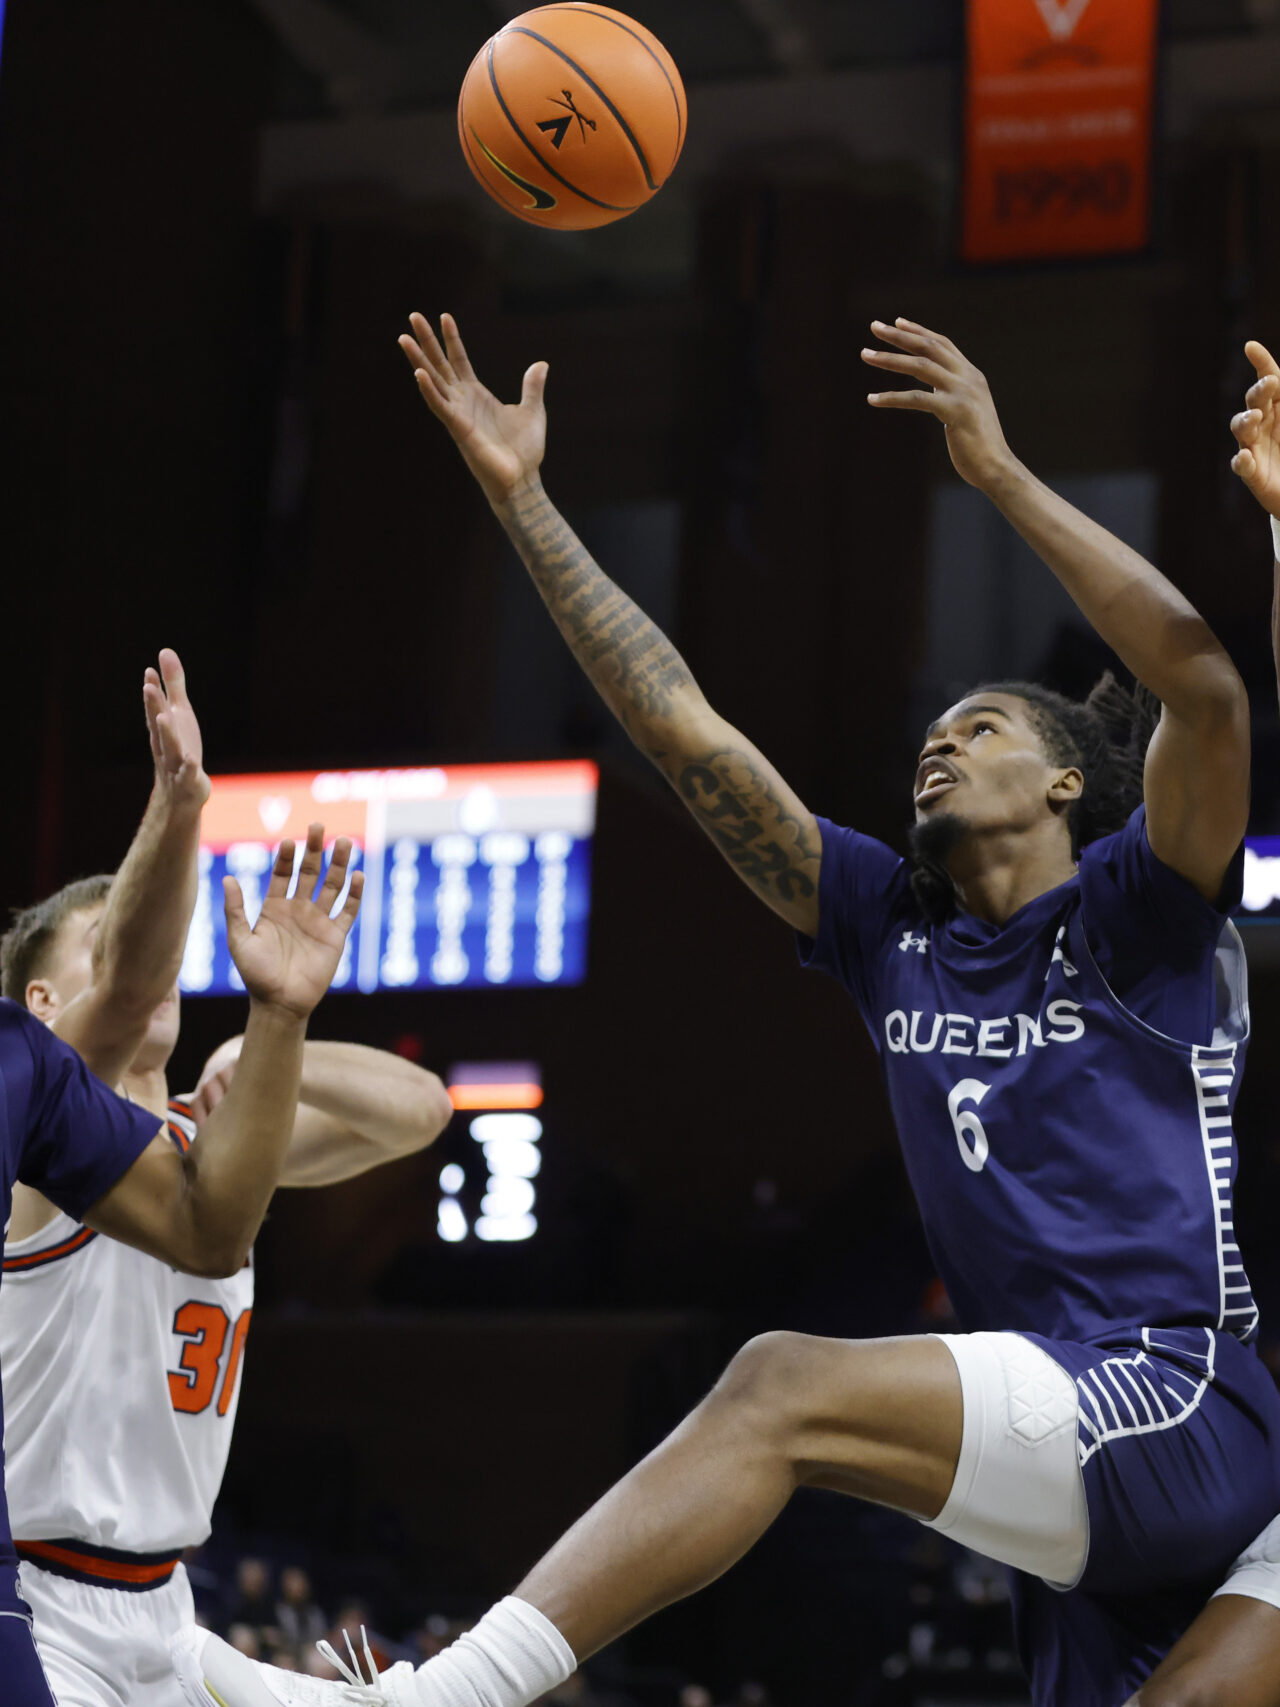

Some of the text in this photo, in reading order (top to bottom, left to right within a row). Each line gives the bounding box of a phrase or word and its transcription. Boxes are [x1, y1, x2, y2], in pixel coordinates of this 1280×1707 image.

[994, 160, 1134, 224] 1990
[885, 998, 1087, 1059] QUEENS
[947, 1077, 992, 1173] 6
